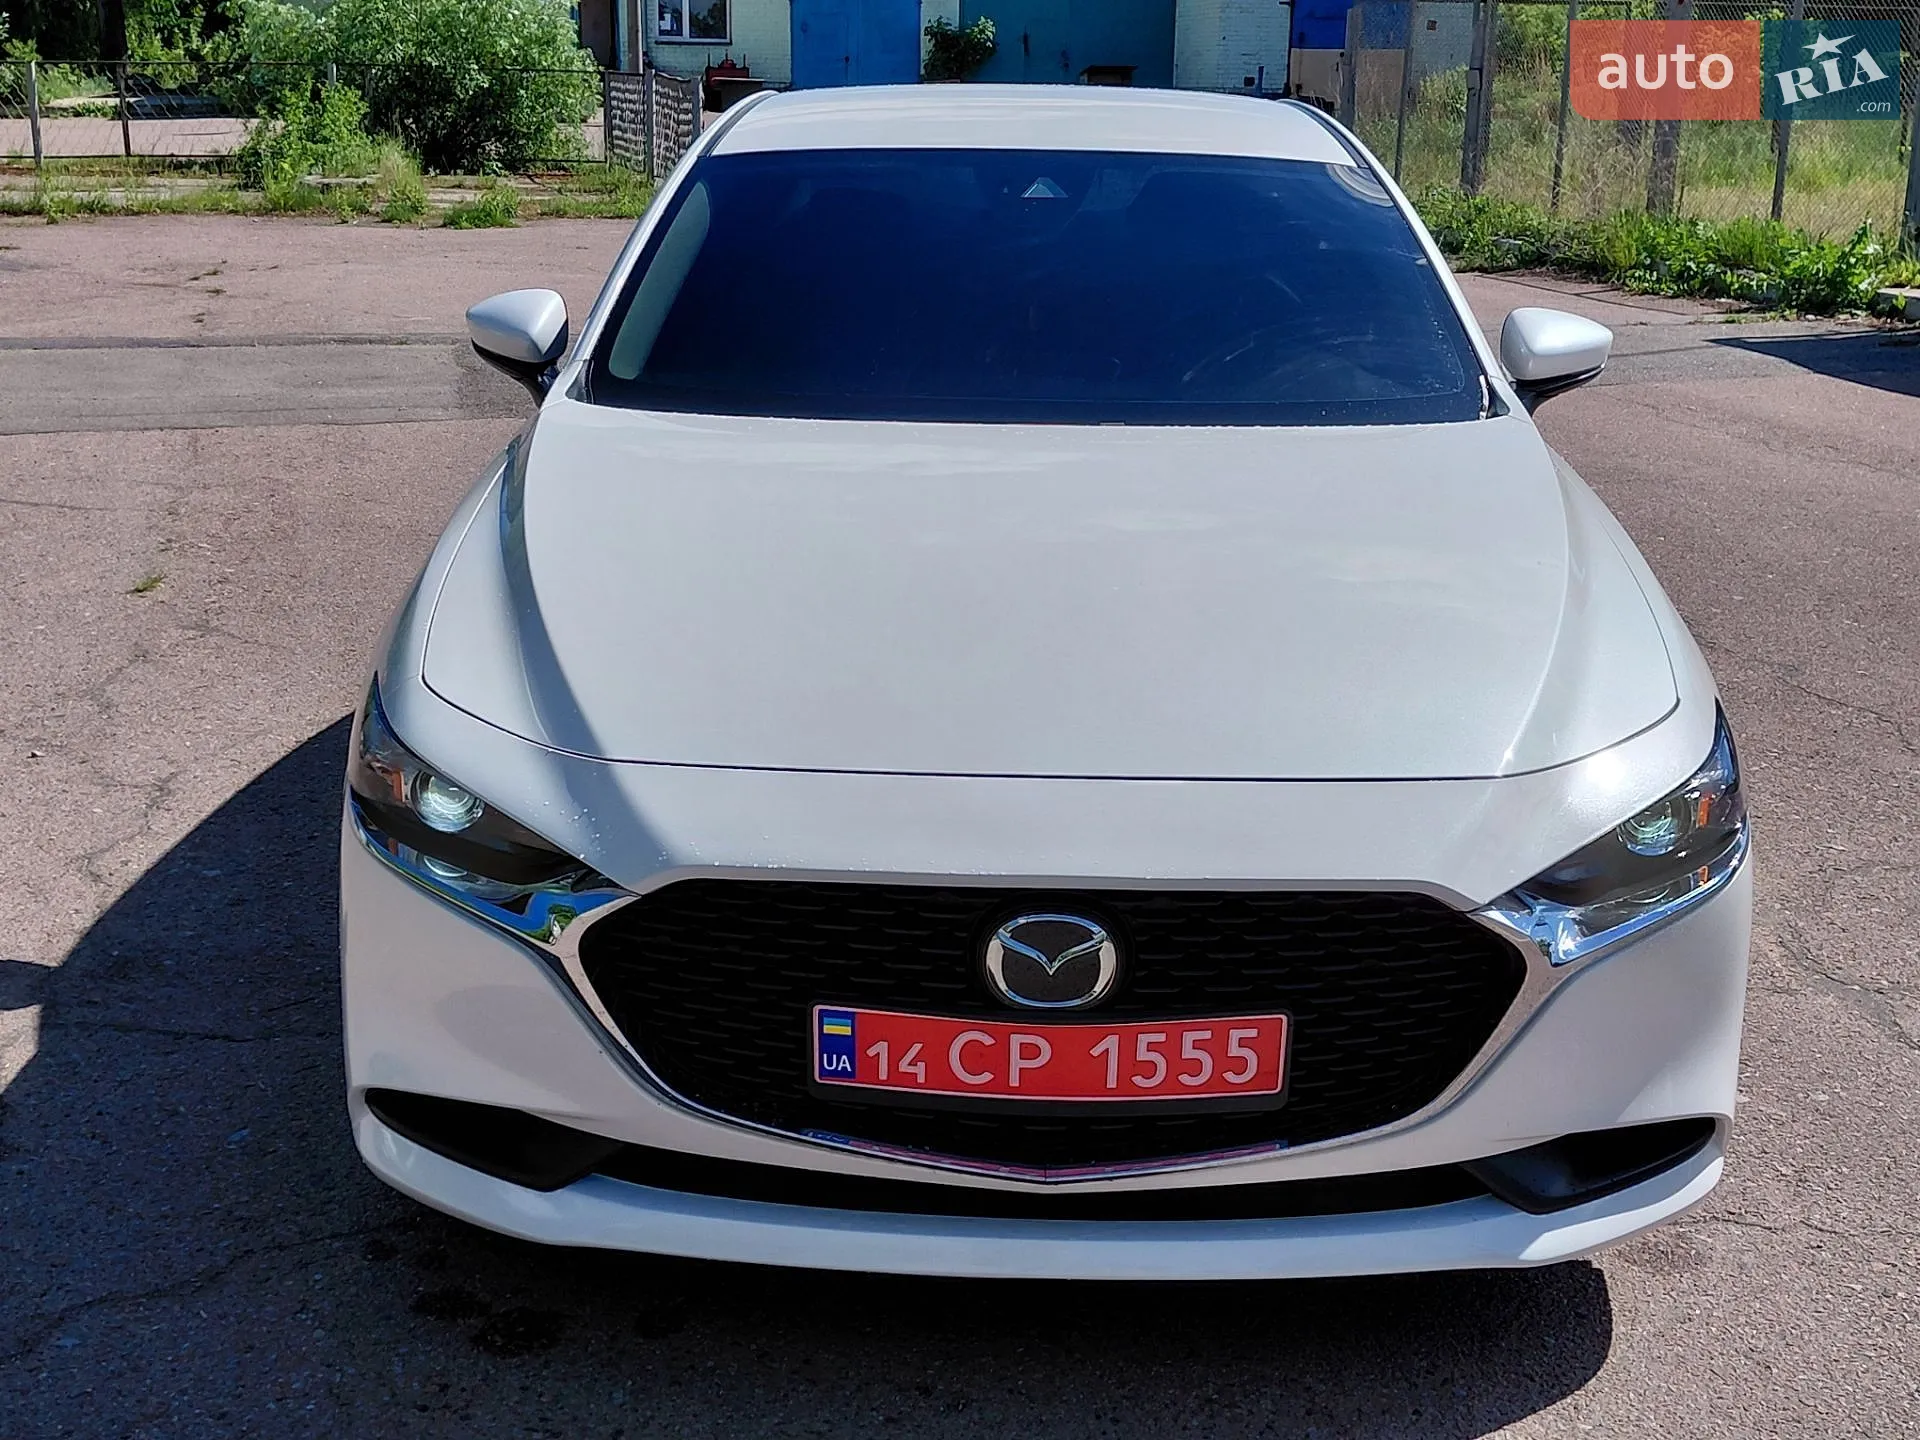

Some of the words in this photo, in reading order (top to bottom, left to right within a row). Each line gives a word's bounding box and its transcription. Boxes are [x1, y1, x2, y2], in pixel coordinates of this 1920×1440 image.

[823, 1053, 852, 1072] UA
[866, 1040, 926, 1084] 14
[948, 1030, 1053, 1087] CP
[1089, 1028, 1259, 1089] 1555
